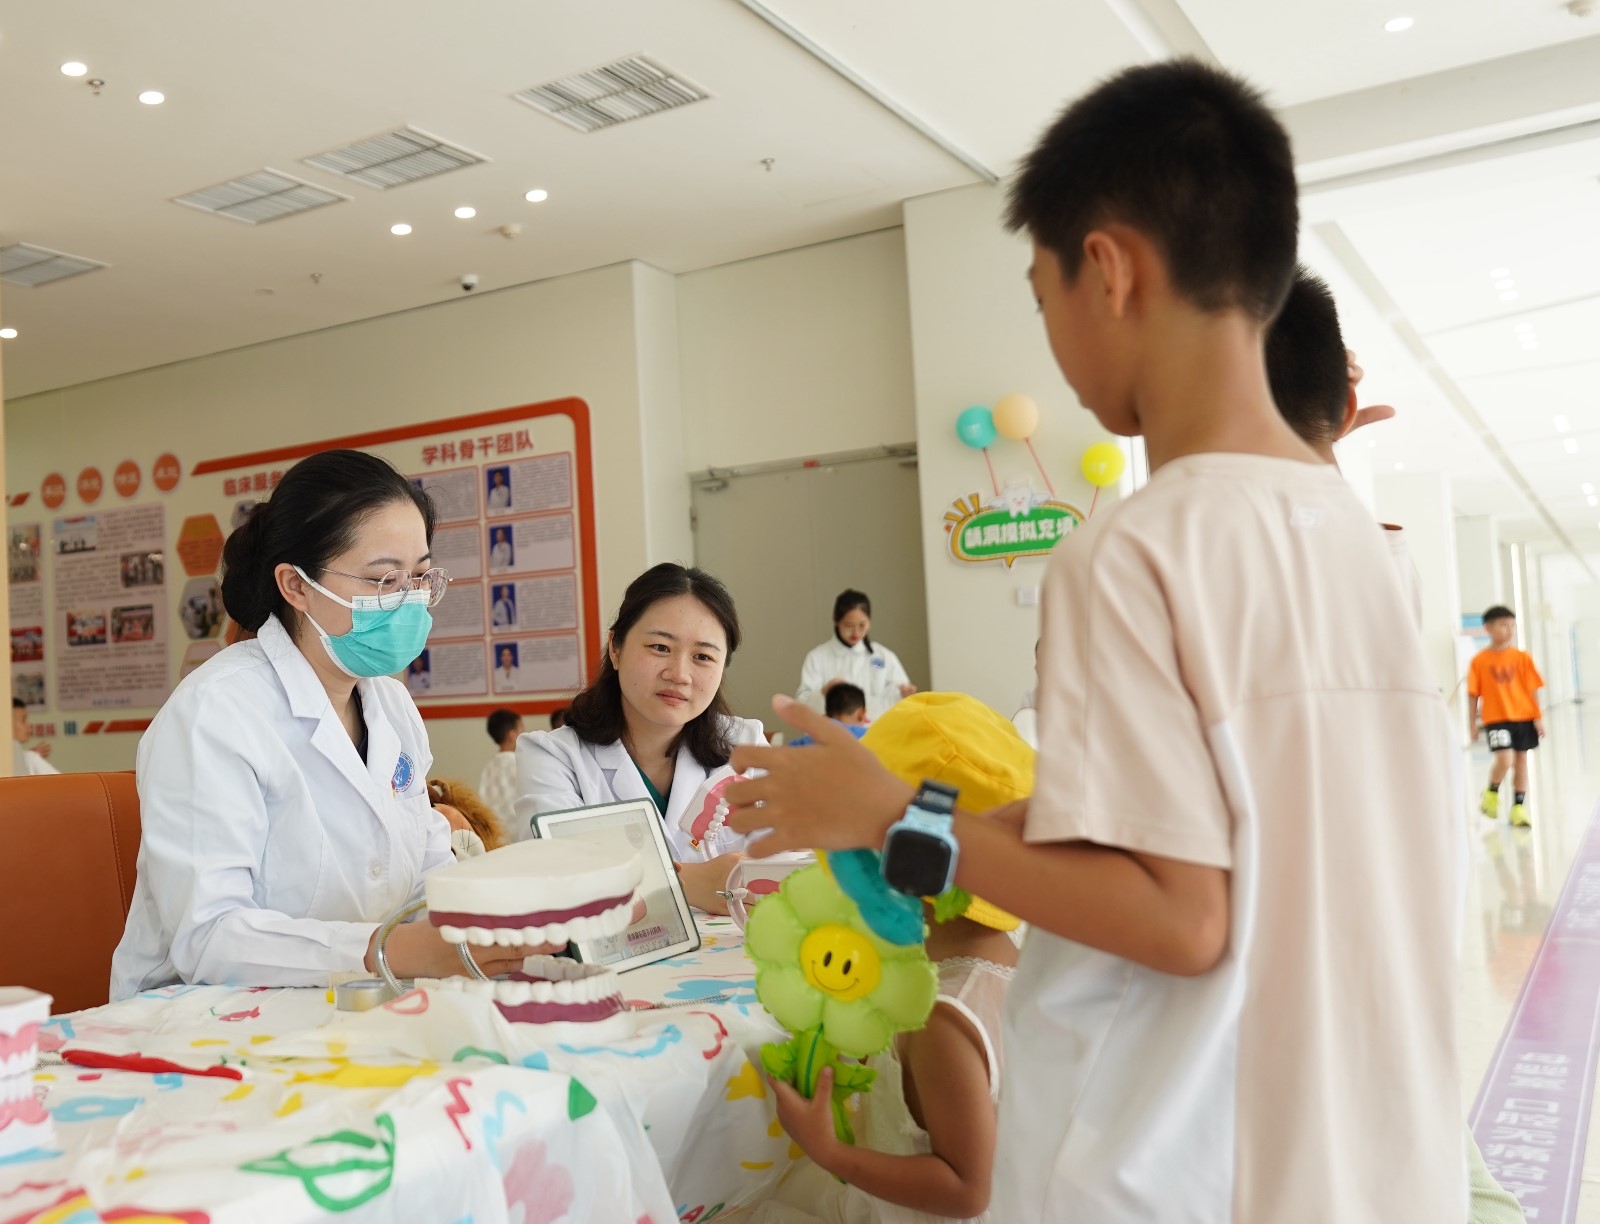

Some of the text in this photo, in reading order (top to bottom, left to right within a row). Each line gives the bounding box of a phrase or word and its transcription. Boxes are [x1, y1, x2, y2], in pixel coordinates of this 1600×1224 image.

[421, 429, 534, 466] 学科骨干团队
